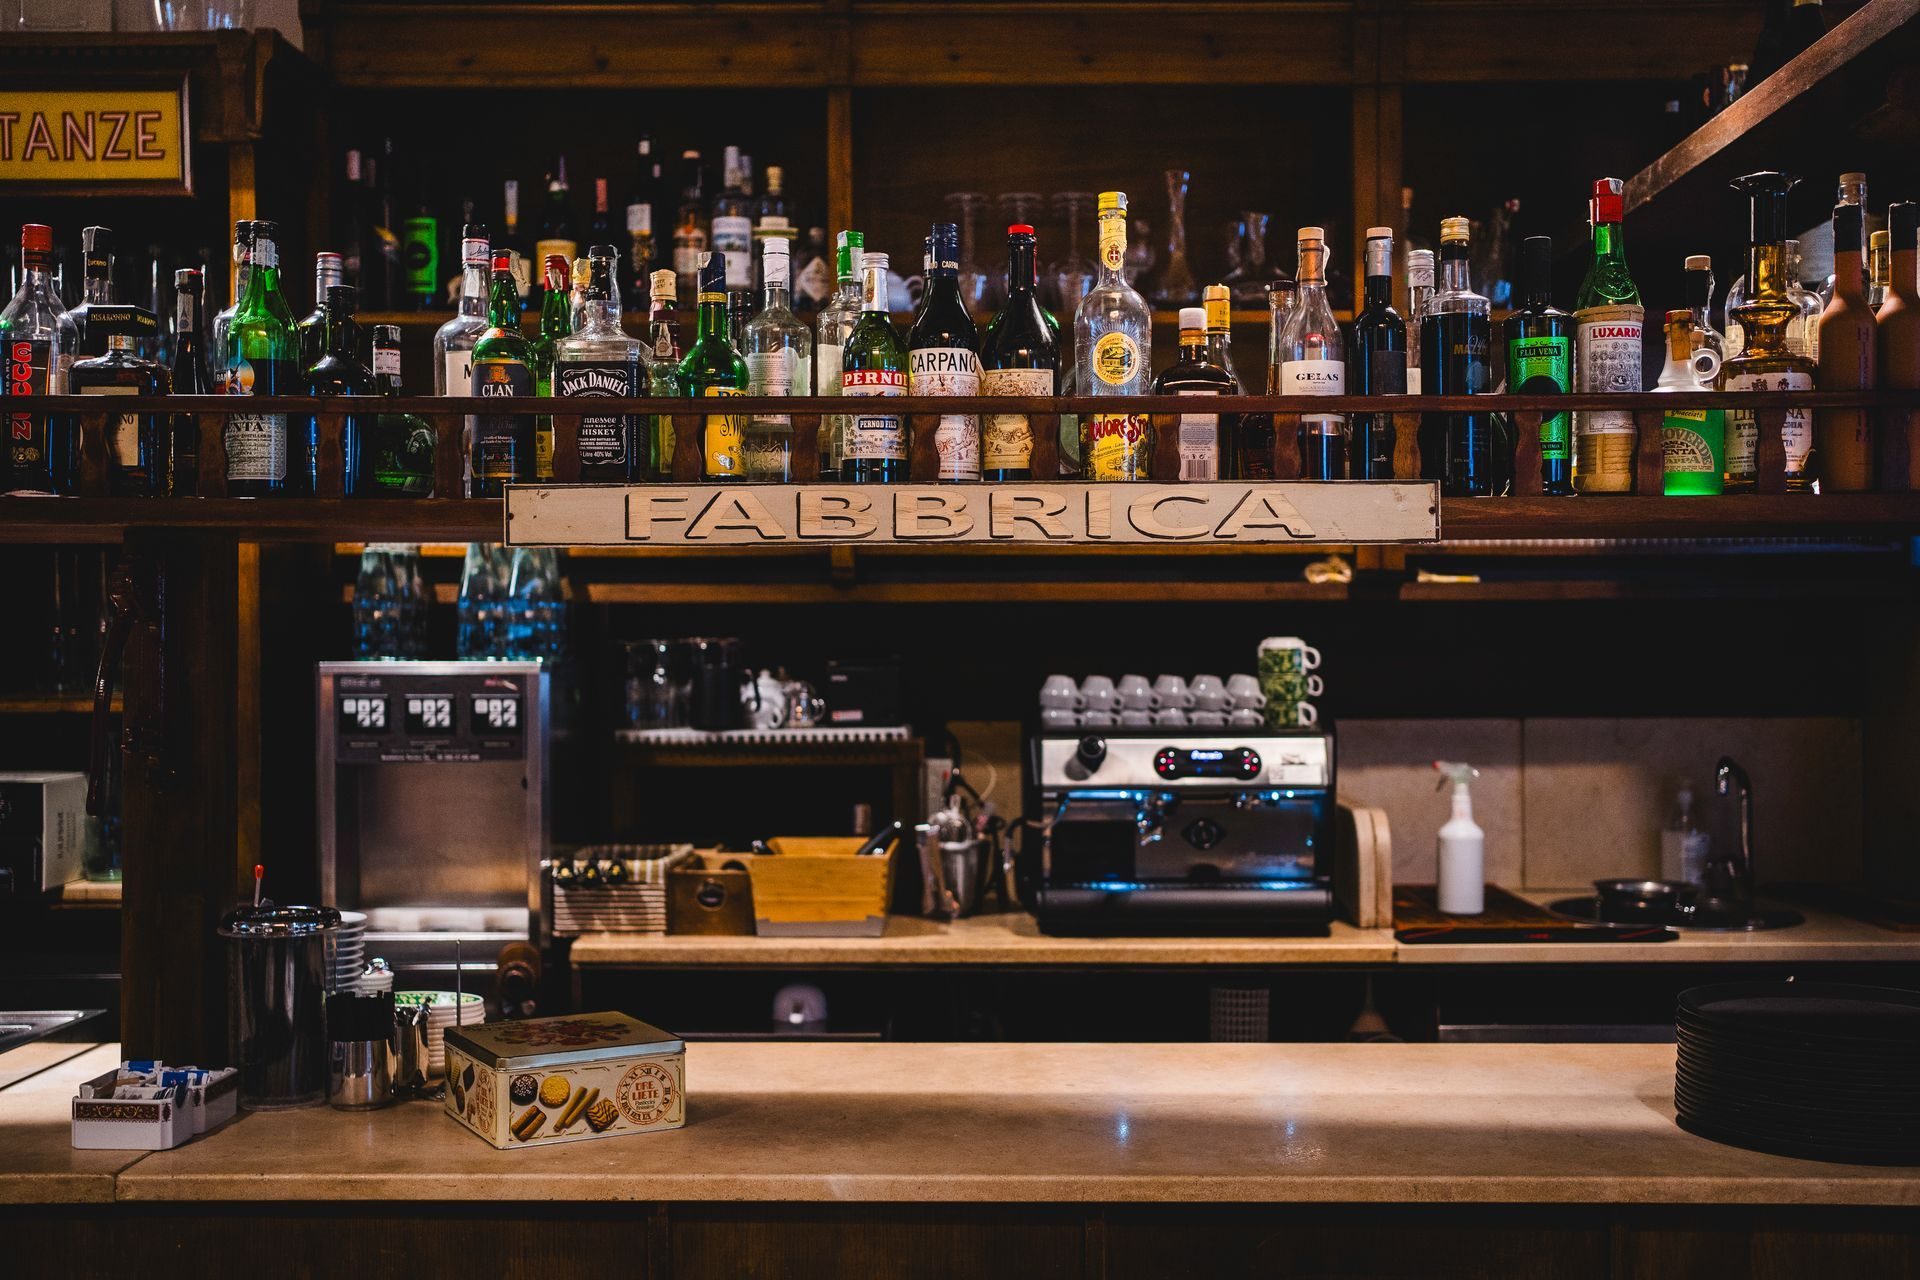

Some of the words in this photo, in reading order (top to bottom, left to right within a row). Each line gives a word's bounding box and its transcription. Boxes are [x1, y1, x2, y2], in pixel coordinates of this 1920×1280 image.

[91, 313, 131, 322] DISARONNO
[1592, 327, 1641, 339] LUXARDO
[1539, 348, 1559, 356] VENA
[910, 352, 977, 374] CARPANO
[1296, 372, 1339, 382] GELAS
[562, 375, 589, 397] JACK
[588, 371, 631, 397] DANIEL'S
[482, 384, 515, 397] CLAN
[859, 419, 885, 429] PERNOD
[885, 419, 897, 429] FILS
[582, 428, 616, 436] HISKEY
[625, 488, 1315, 541] FABBRICA
[632, 1089, 660, 1101] LIETE
